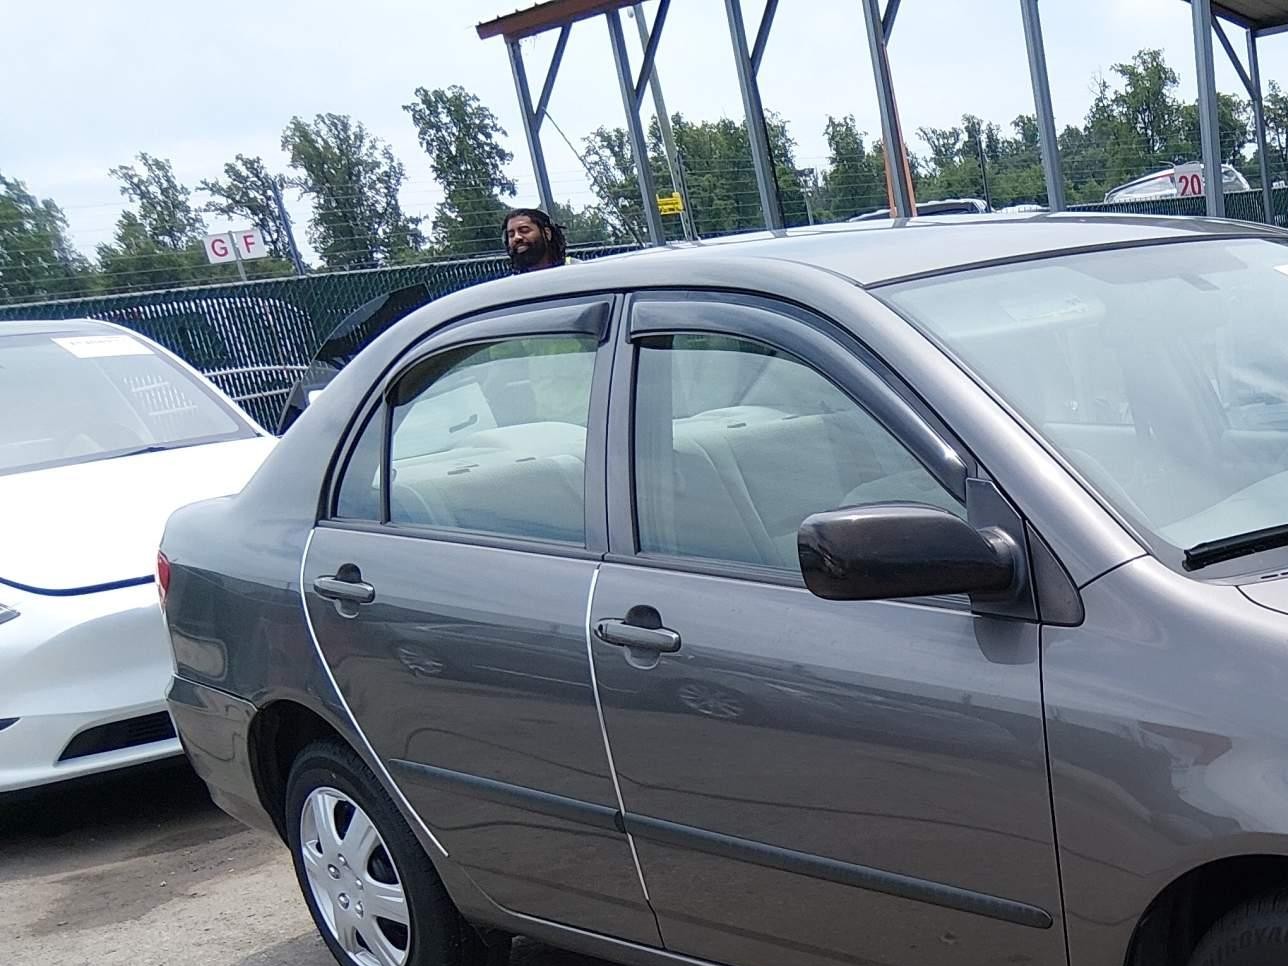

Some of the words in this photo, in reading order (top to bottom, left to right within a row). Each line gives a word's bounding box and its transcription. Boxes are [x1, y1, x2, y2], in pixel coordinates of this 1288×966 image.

[1178, 174, 1202, 197] 20
[211, 238, 229, 258] G
[243, 234, 256, 254] F
